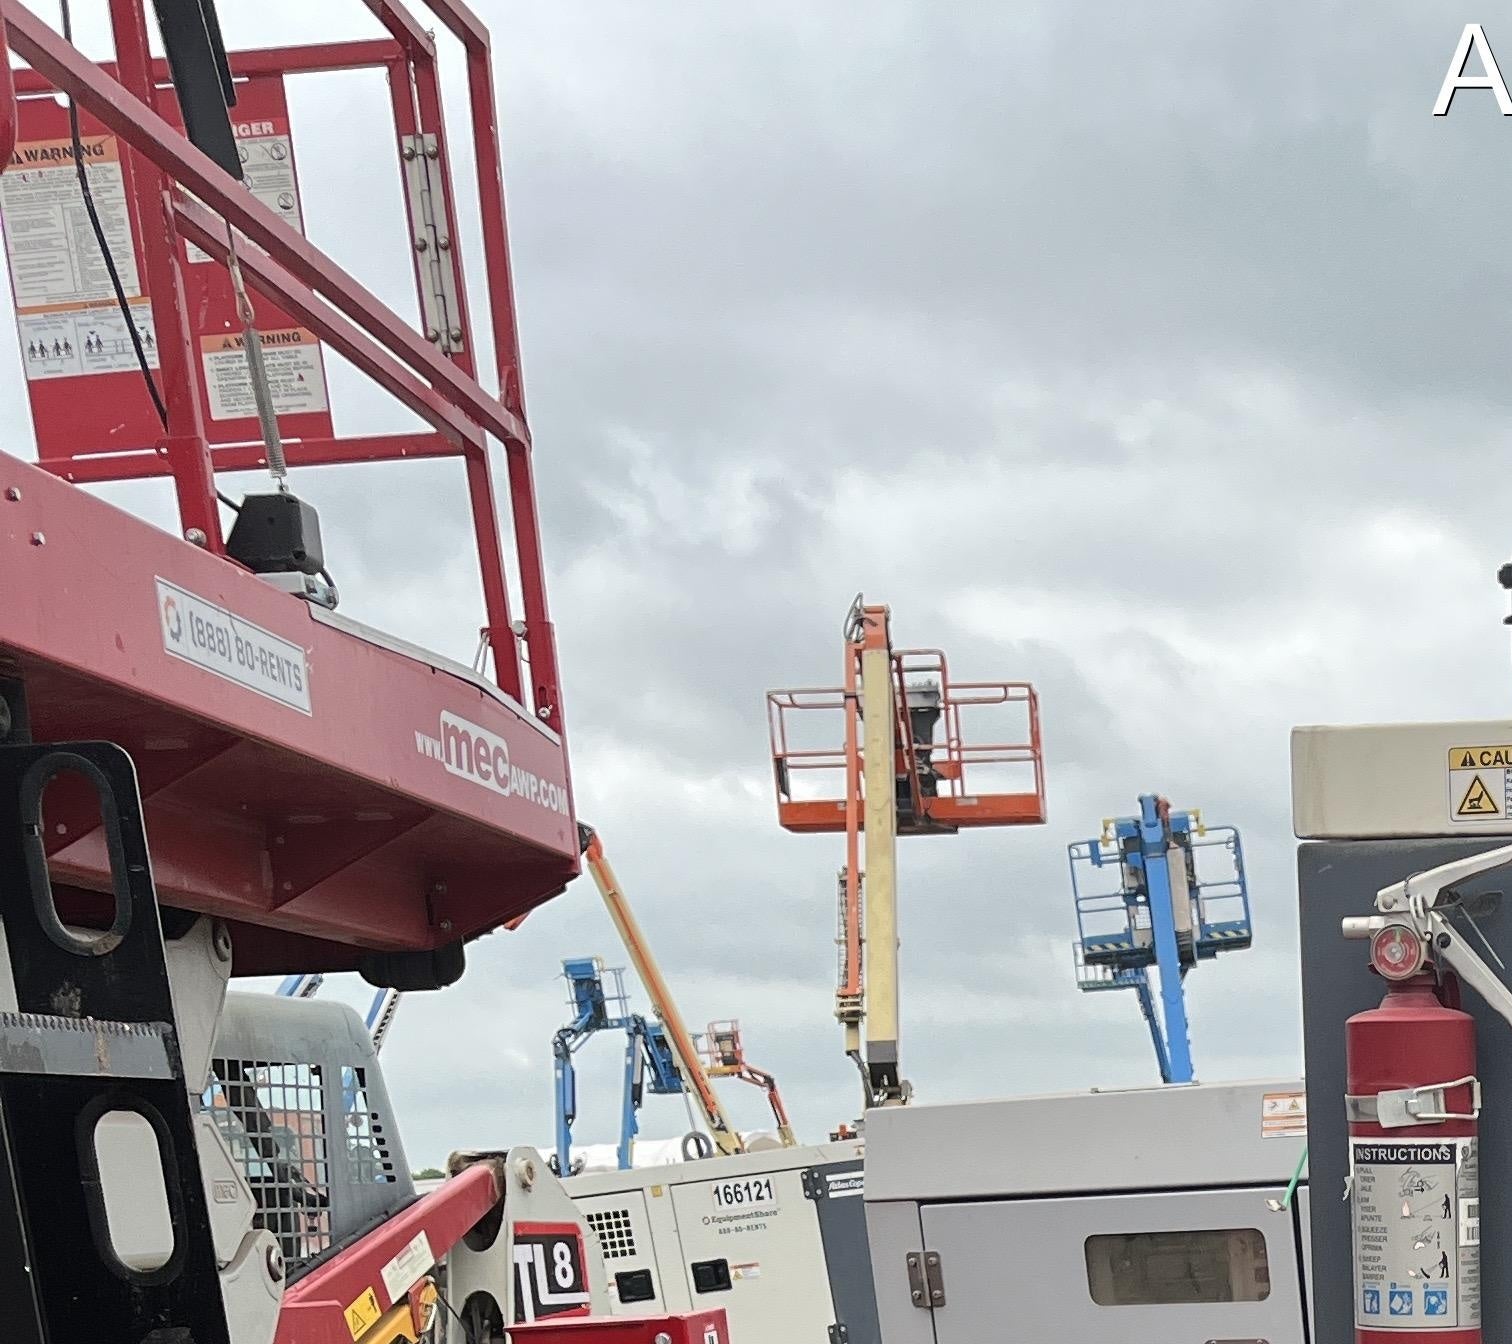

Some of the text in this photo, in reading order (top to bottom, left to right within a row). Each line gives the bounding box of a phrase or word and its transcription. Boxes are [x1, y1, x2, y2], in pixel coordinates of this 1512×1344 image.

[24, 144, 105, 163] WARNNG
[234, 331, 302, 347] WRNING
[188, 611, 303, 692] (888) 80-RENTS
[1356, 1147, 1451, 1162] INSTRUCTIONS
[713, 1178, 774, 1206] 166121
[513, 1242, 590, 1323] TL8
